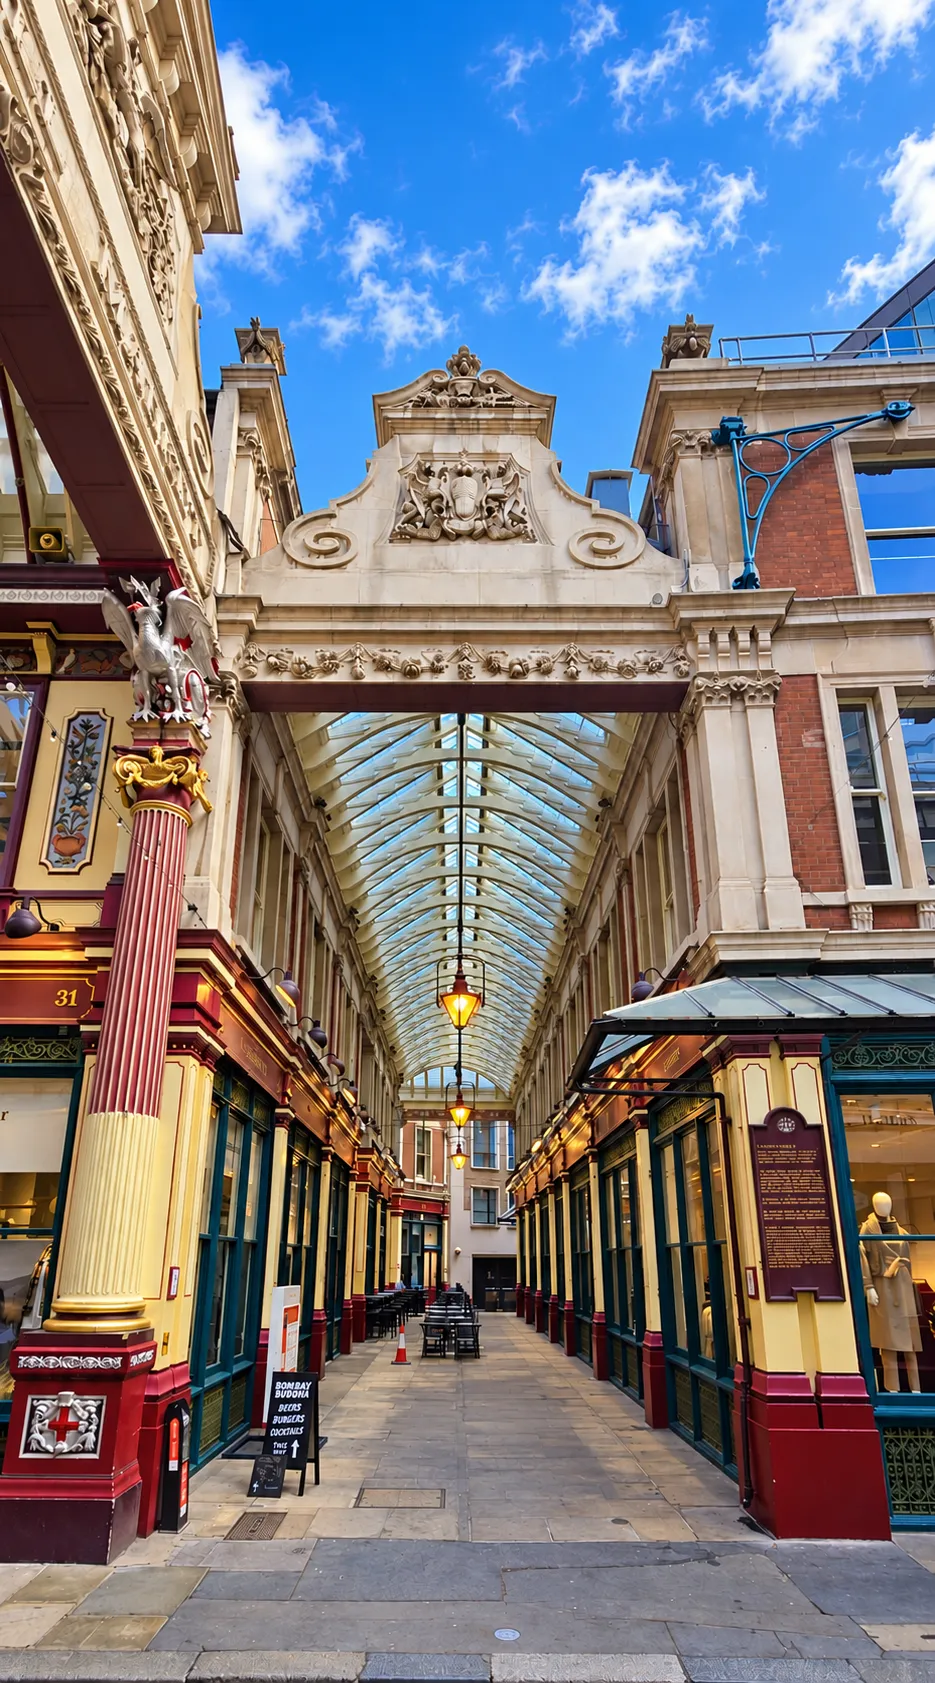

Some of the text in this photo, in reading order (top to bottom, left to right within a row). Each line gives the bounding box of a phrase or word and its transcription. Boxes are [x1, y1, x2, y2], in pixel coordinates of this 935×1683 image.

[54, 989, 78, 1007] 31
[275, 1381, 312, 1390] BOMBAY
[278, 1403, 302, 1412] BEERS
[272, 1414, 305, 1424] BURGERS
